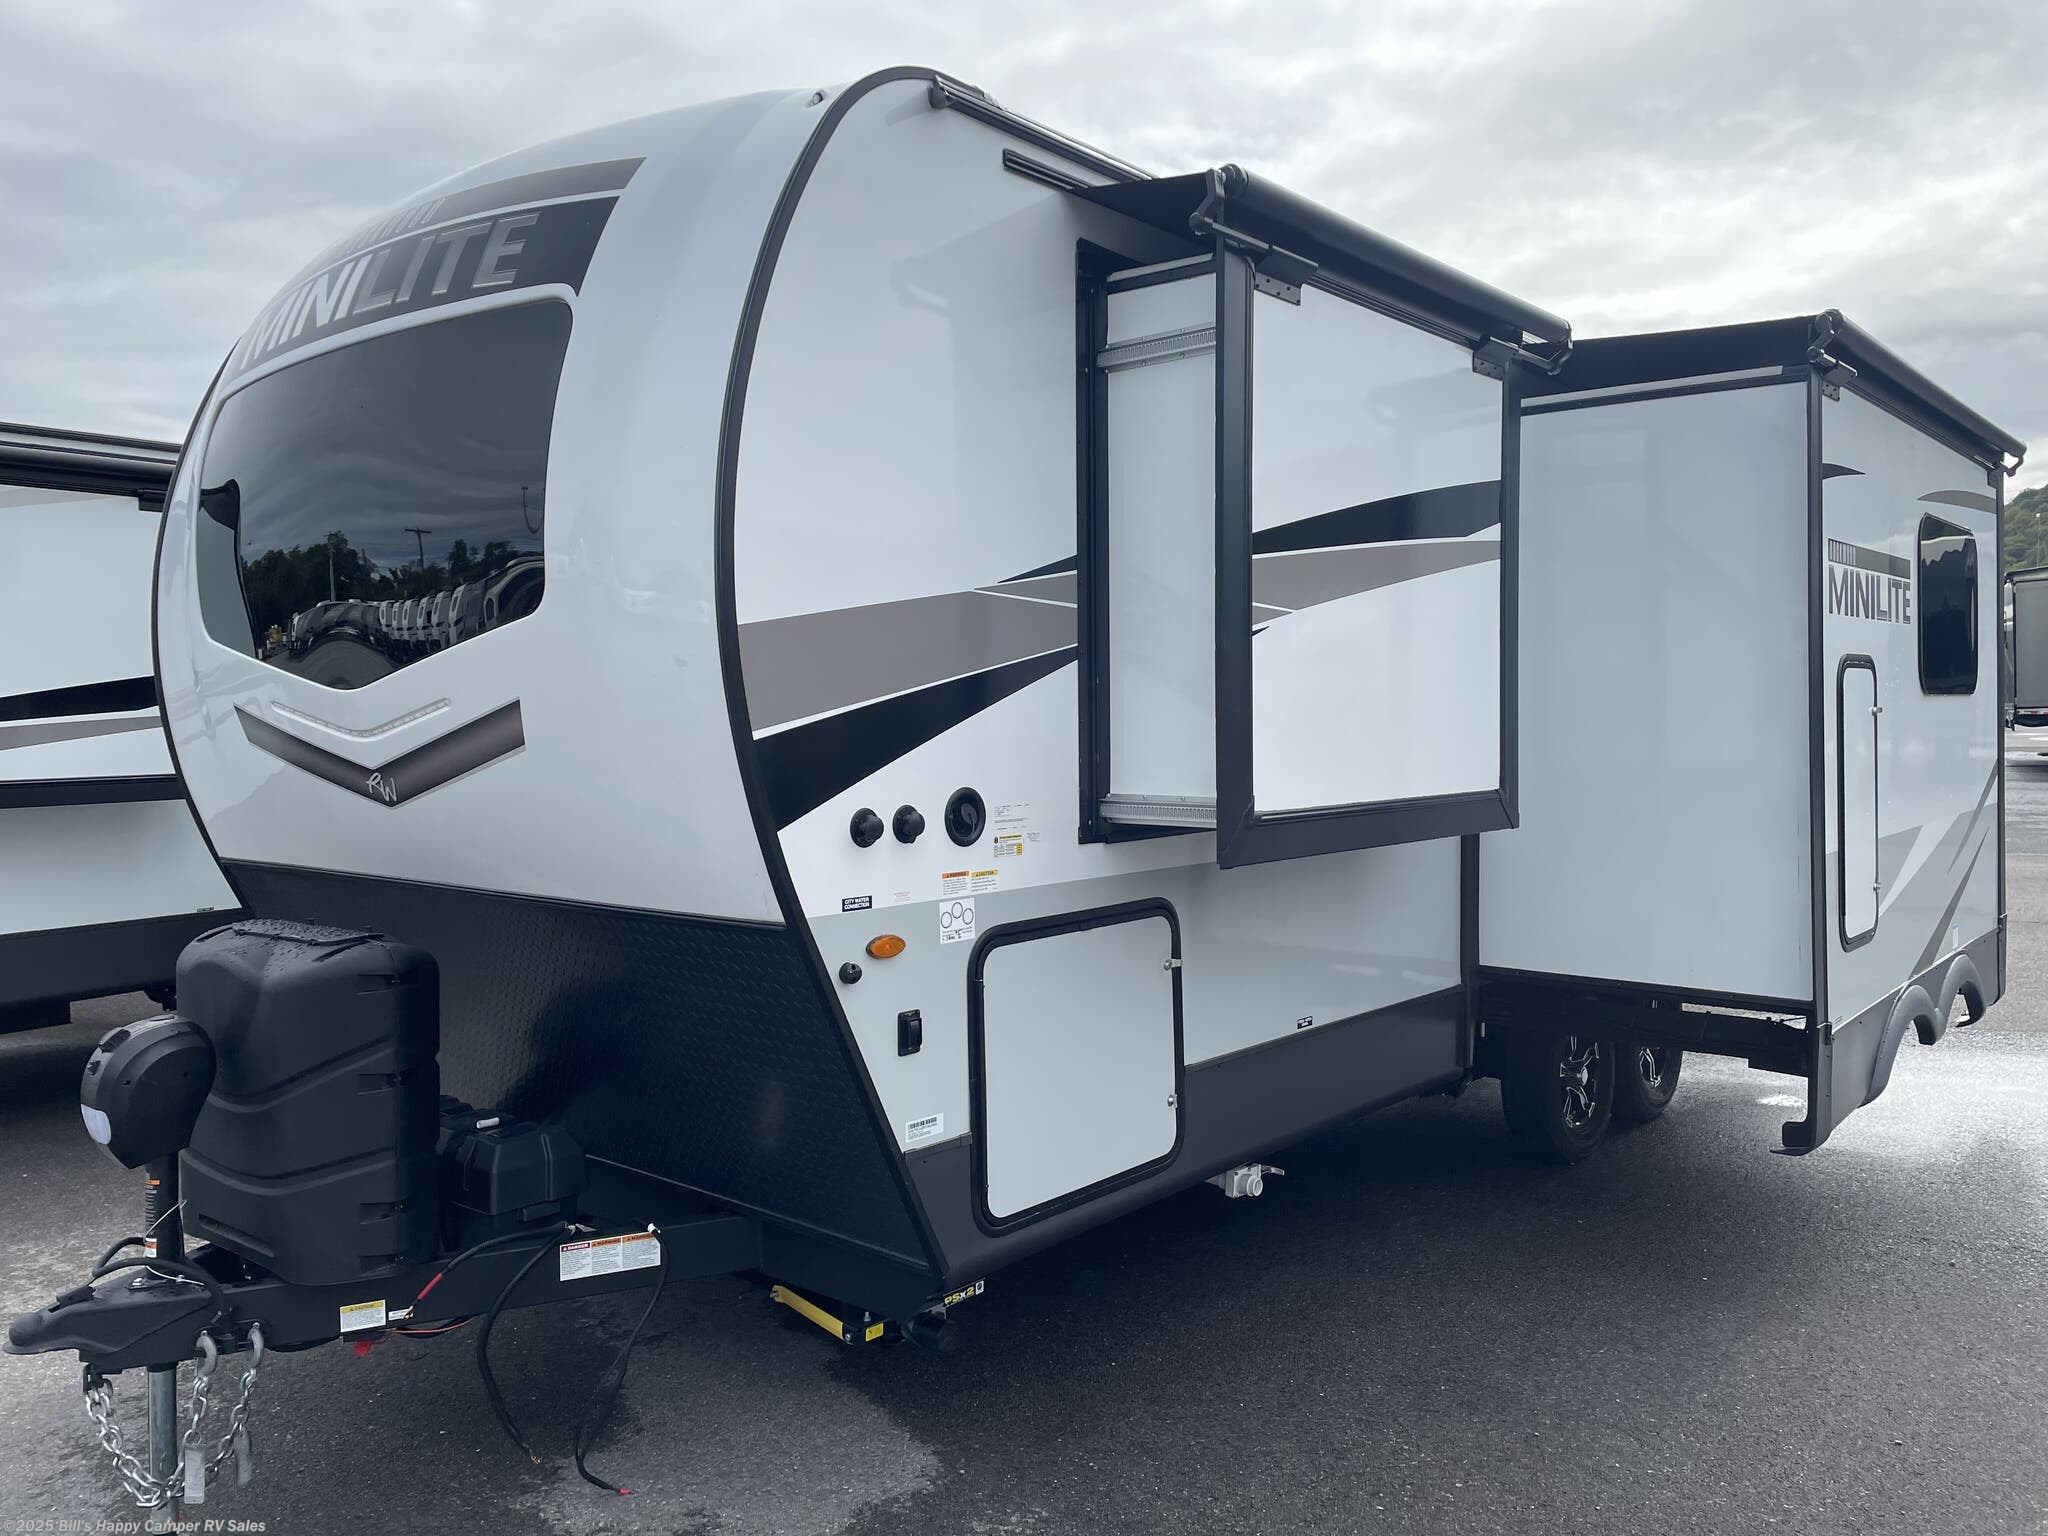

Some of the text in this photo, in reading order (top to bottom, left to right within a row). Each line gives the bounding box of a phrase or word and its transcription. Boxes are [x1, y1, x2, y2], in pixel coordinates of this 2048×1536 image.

[240, 210, 542, 371] MINILITE
[1828, 563, 1911, 625] MINILITE
[366, 772, 398, 802] RW
